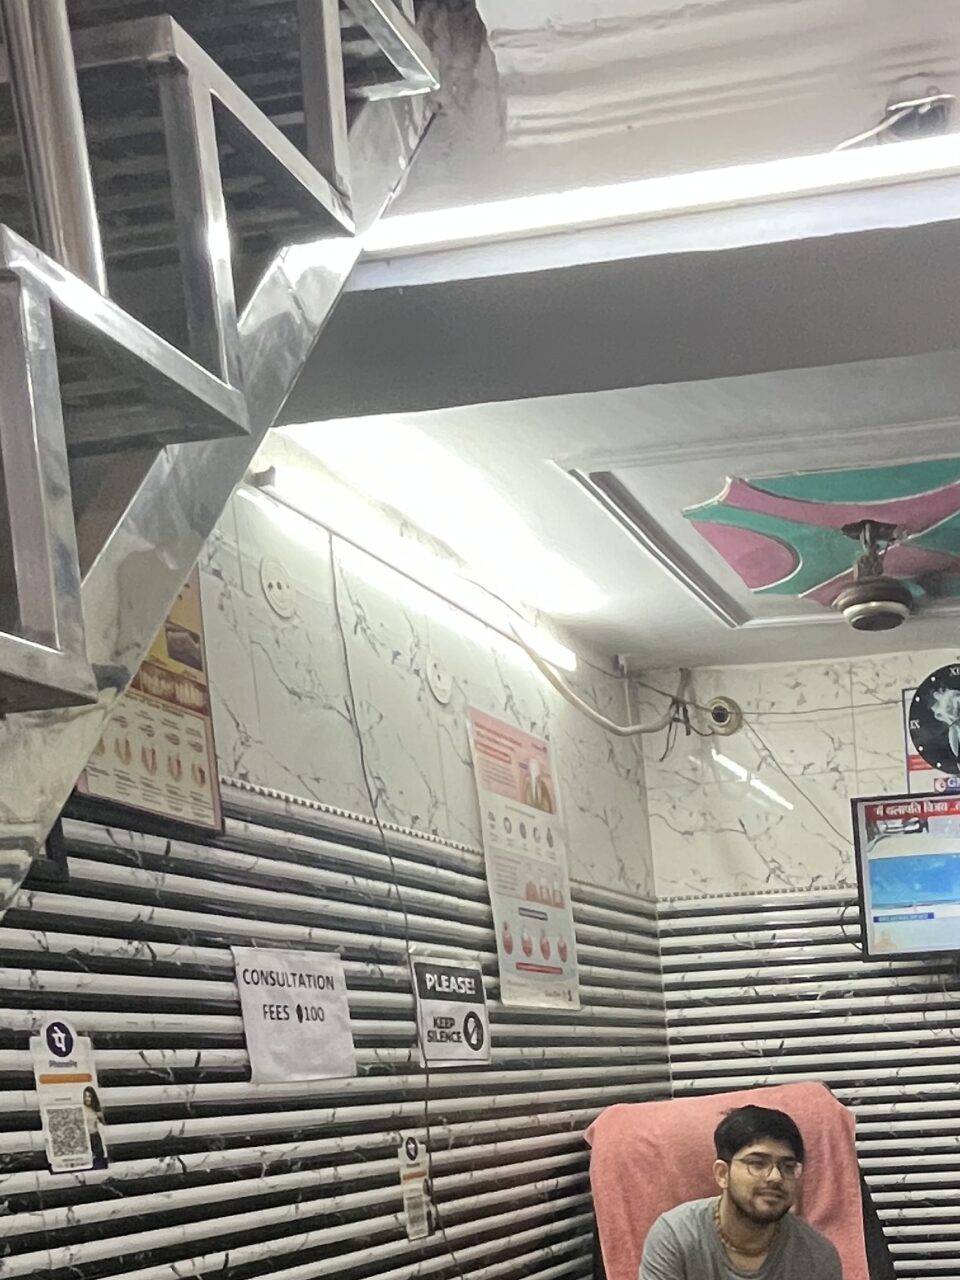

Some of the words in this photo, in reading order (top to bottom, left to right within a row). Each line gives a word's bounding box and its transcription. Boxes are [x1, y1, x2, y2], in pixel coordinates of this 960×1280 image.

[910, 719, 920, 729] IX
[242, 968, 335, 991] CONSULTATION
[425, 972, 476, 995] PLEASE!
[262, 1003, 290, 1021] FEES
[433, 1016, 456, 1029] KEEP
[427, 1030, 463, 1044] SILENCE
